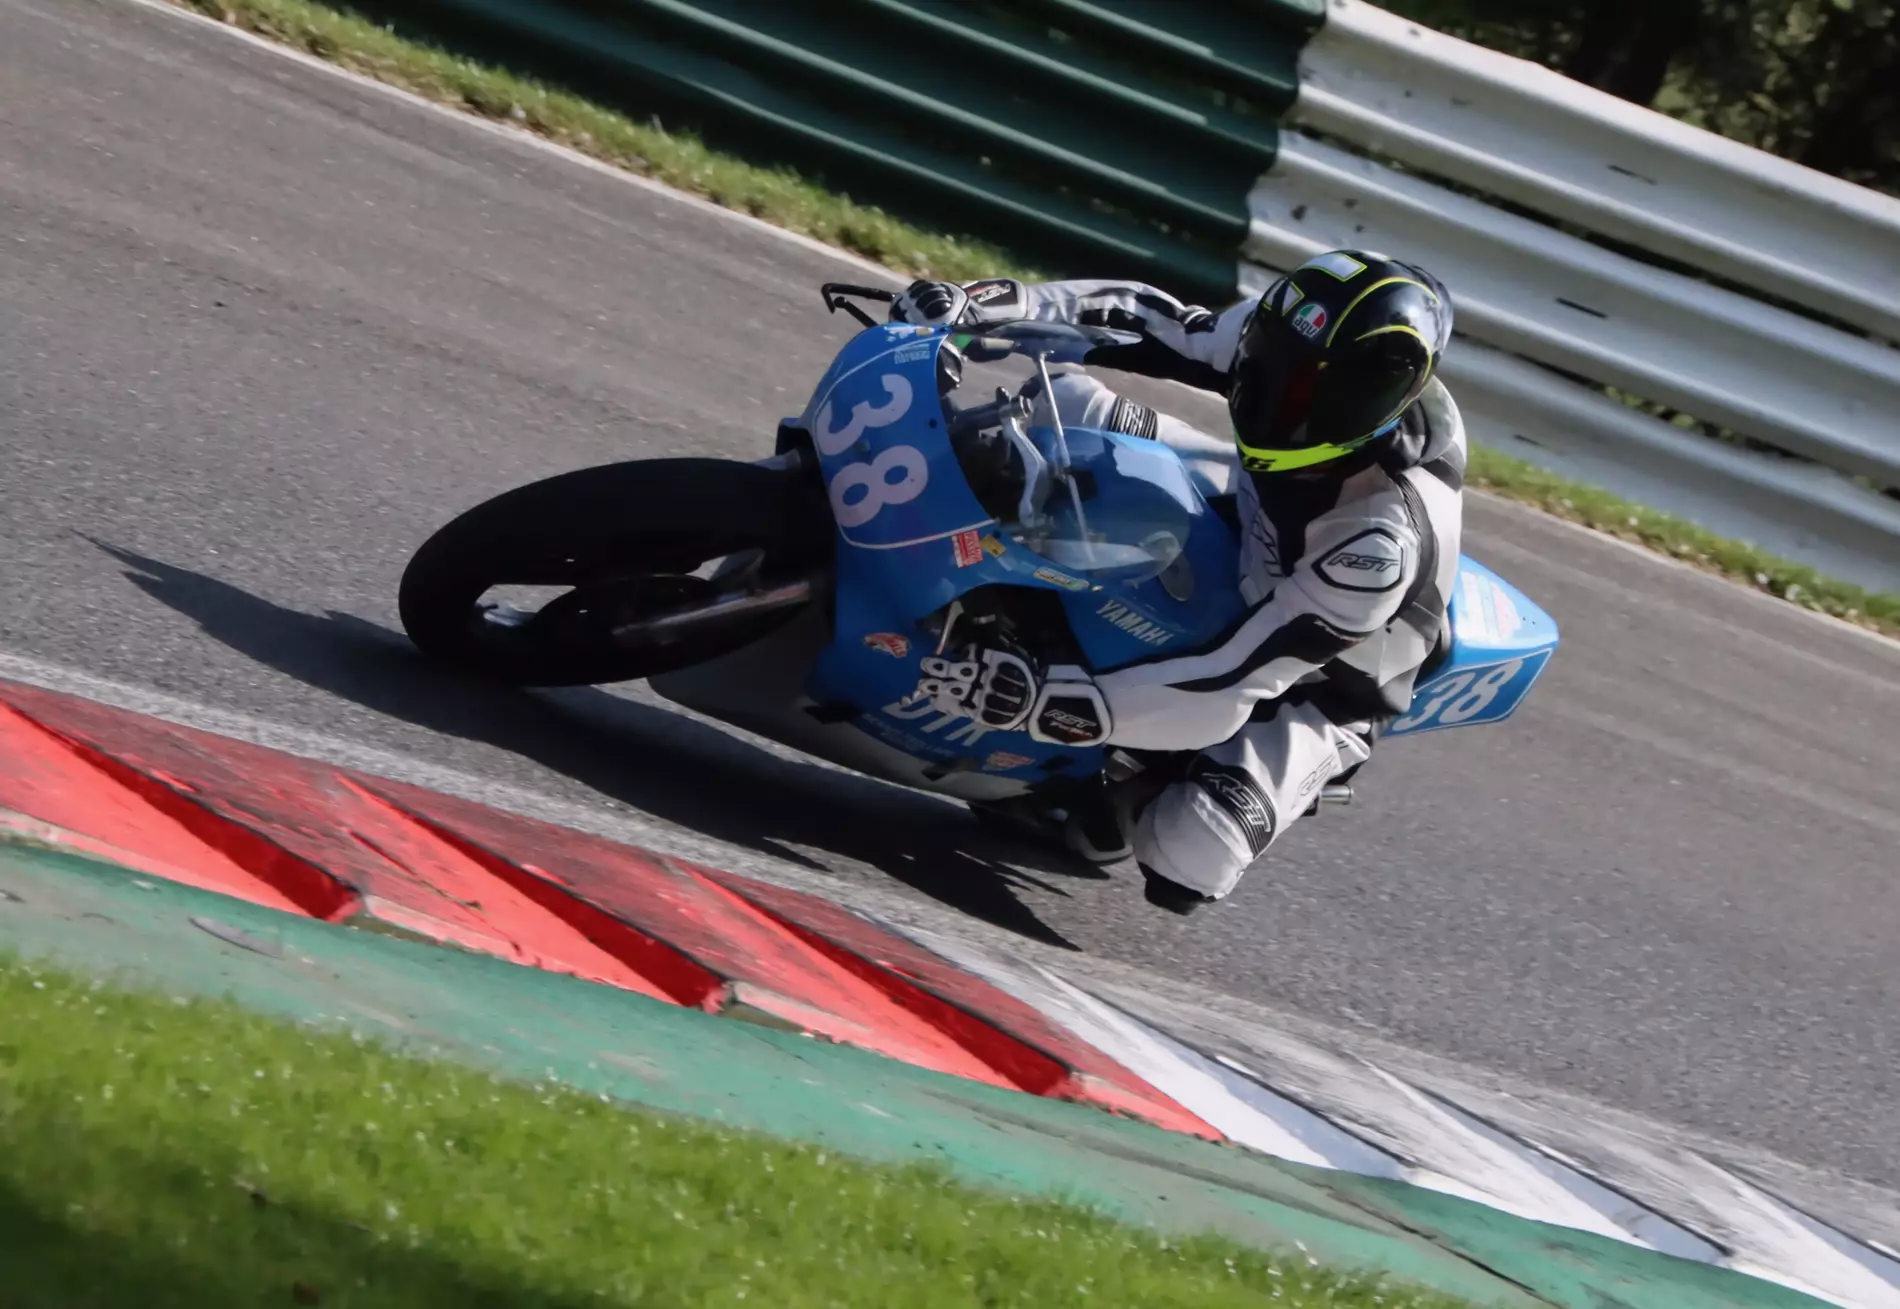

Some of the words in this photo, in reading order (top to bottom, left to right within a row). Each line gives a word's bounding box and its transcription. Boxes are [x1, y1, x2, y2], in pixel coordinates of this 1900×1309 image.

[816, 373, 929, 528] 38
[1327, 552, 1399, 573] RST
[1097, 600, 1174, 646] YAMAHA
[1392, 660, 1522, 732] 38
